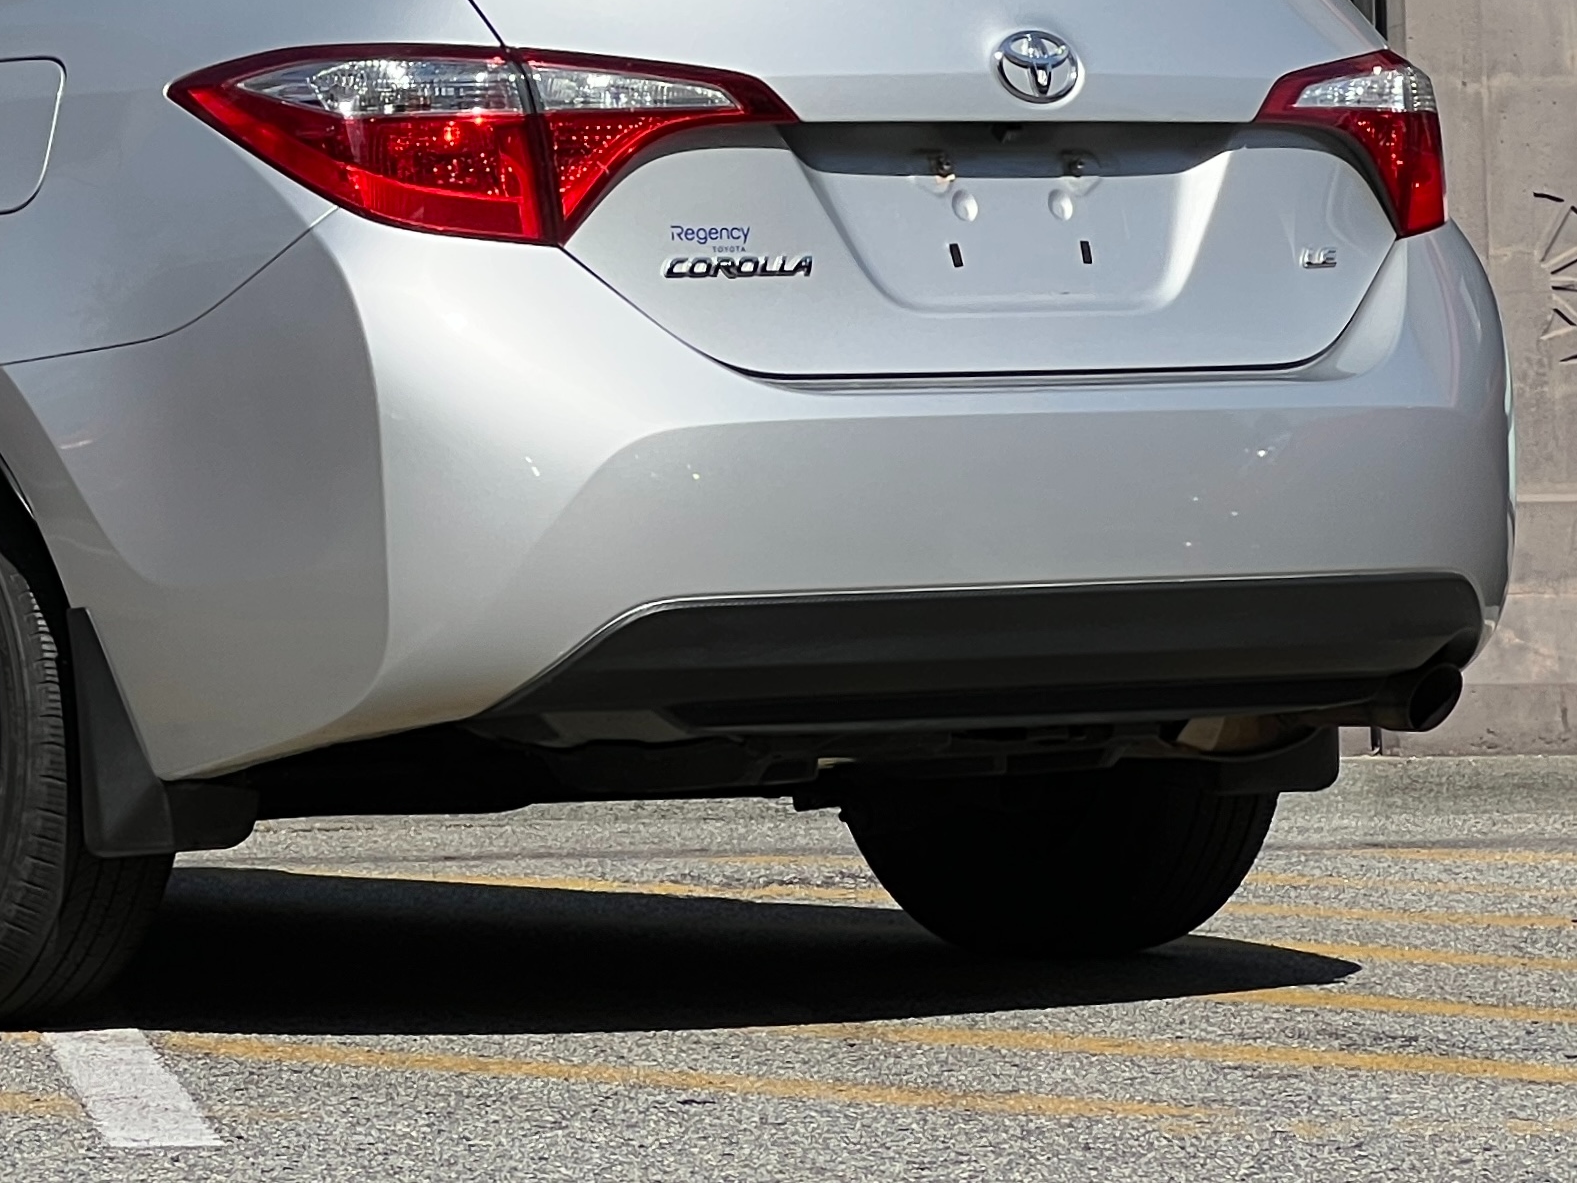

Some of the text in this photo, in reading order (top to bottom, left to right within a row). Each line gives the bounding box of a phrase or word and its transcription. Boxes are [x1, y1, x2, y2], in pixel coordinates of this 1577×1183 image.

[670, 225, 751, 245] Regency
[711, 245, 747, 253] TOYOTA
[1300, 248, 1338, 270] LE
[662, 255, 814, 280] COROLLA
